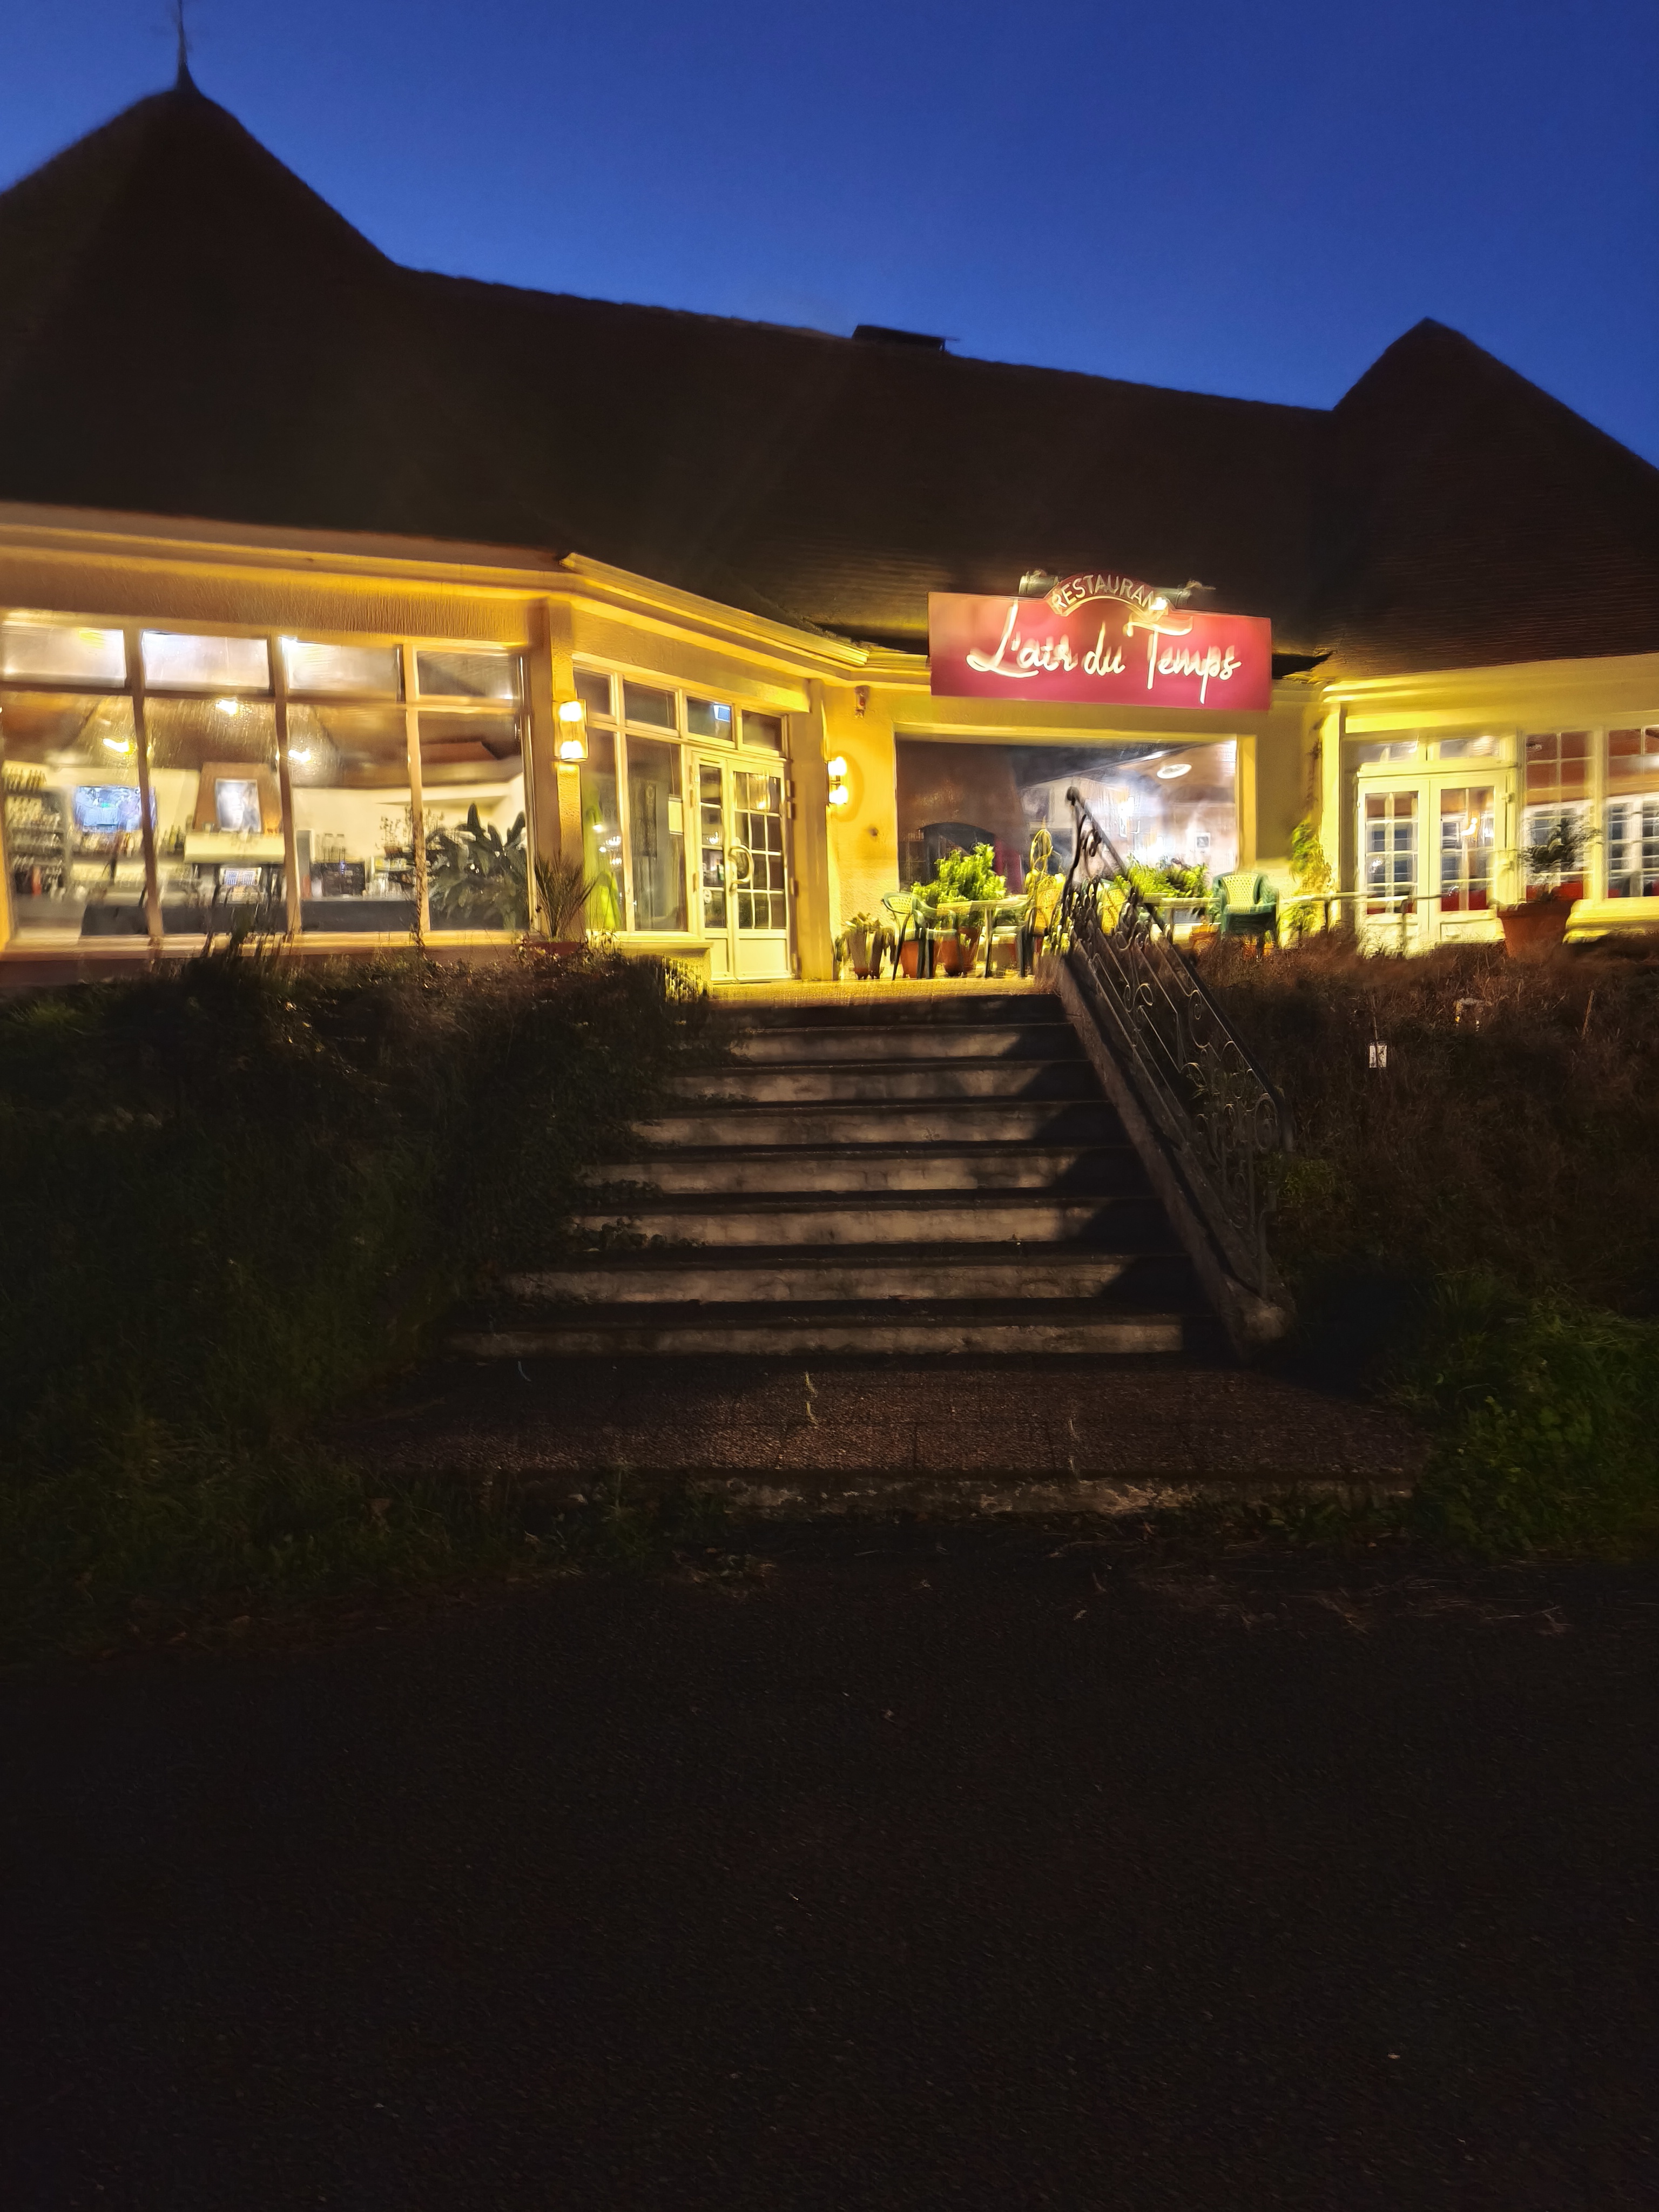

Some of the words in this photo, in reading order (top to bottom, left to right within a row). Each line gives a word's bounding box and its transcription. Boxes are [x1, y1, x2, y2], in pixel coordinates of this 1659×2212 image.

[1051, 574, 1164, 610] RESTAURAN
[966, 599, 1078, 678] L'air
[1082, 622, 1126, 676] du
[1123, 617, 1242, 704] Temps
